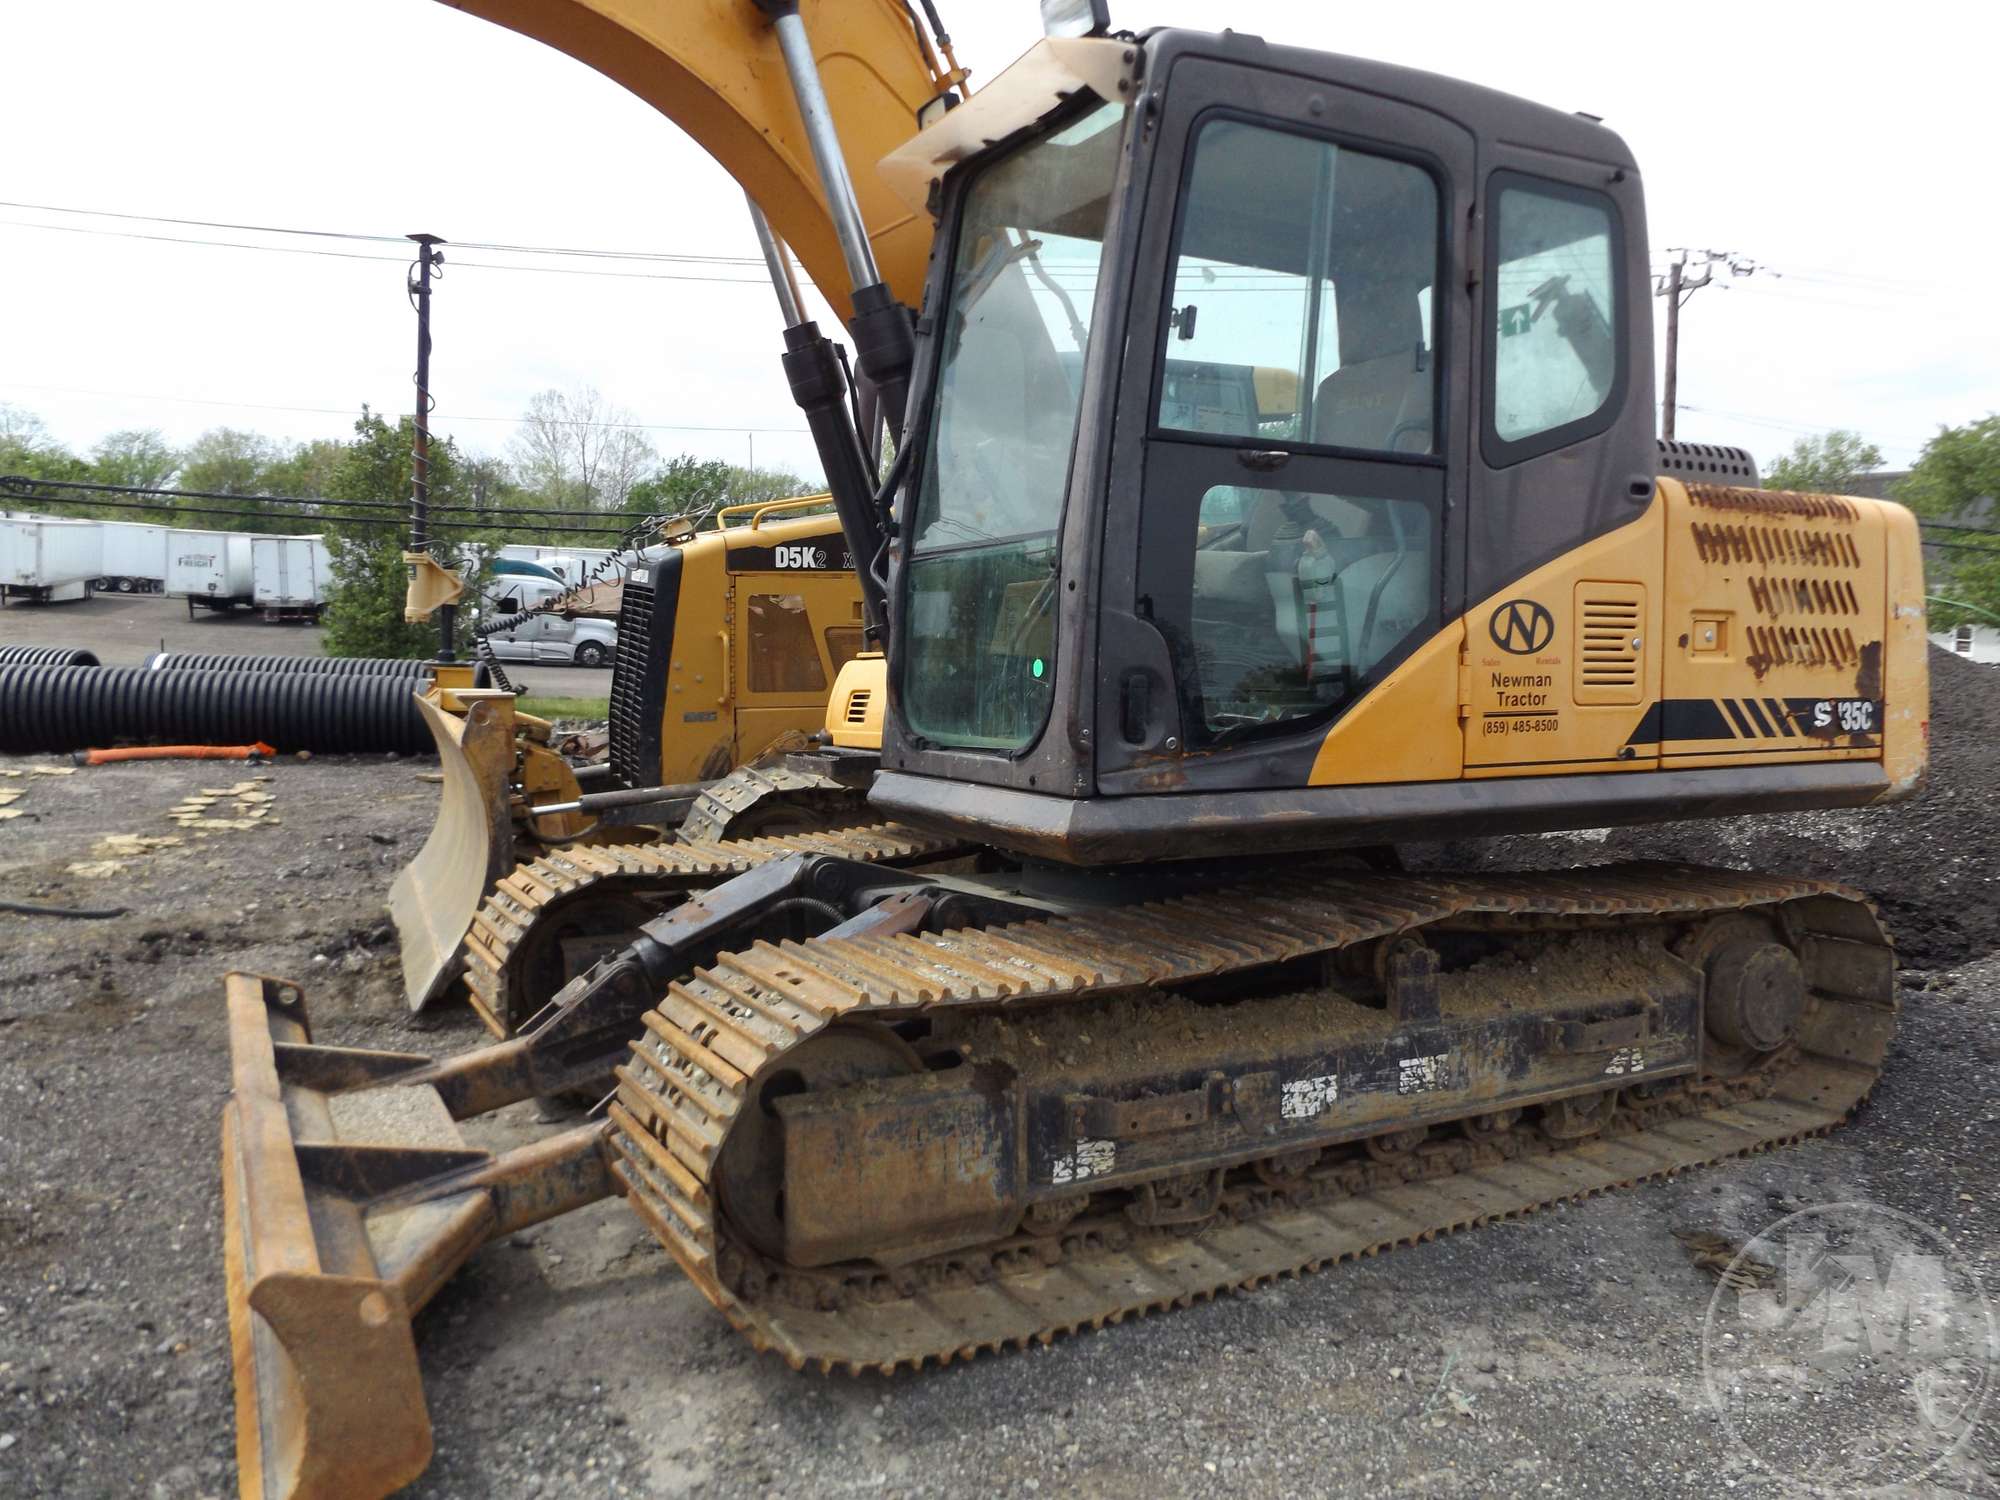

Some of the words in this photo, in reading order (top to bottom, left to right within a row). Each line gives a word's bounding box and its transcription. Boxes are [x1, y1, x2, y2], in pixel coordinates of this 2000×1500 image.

[775, 546, 827, 569] D5K2
[1489, 599, 1554, 655] N
[1491, 671, 1552, 688] Newman
[1497, 691, 1547, 707] Tractor
[1482, 720, 1509, 737] (859)
[1512, 719, 1559, 734] 485-8500
